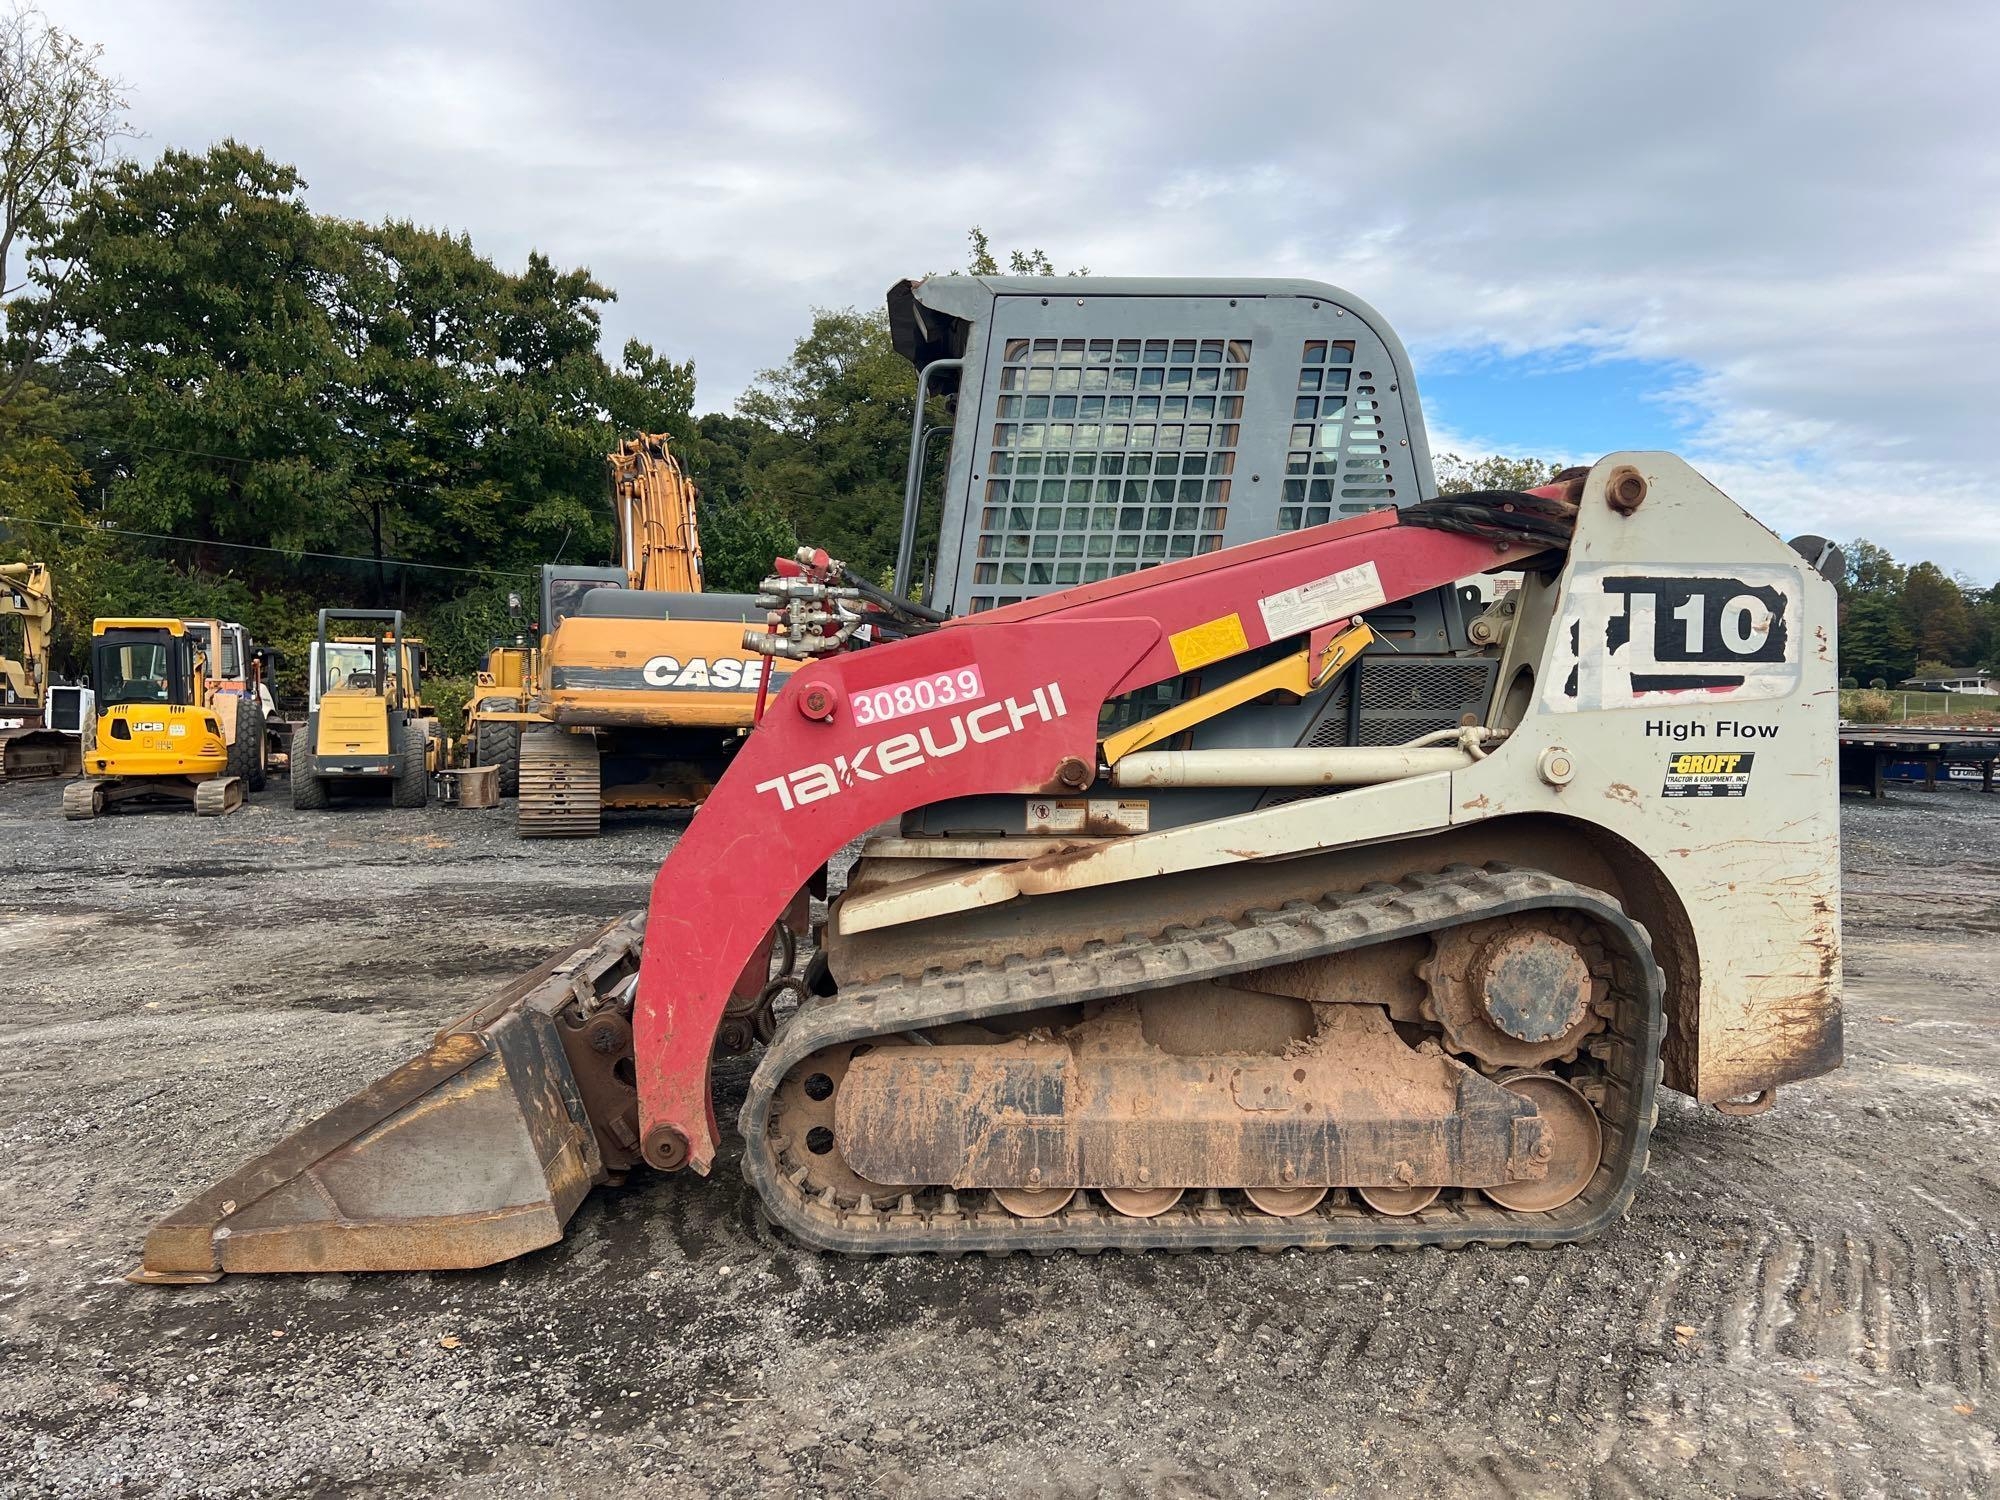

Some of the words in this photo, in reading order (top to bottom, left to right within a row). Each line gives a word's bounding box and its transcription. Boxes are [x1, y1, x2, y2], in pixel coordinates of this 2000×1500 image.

[643, 656, 776, 688] CASE
[853, 669, 979, 724] 308039
[132, 722, 164, 732] JCB
[1645, 720, 1706, 741] High
[1716, 720, 1780, 738] Flow
[1675, 754, 1742, 774] GROFF
